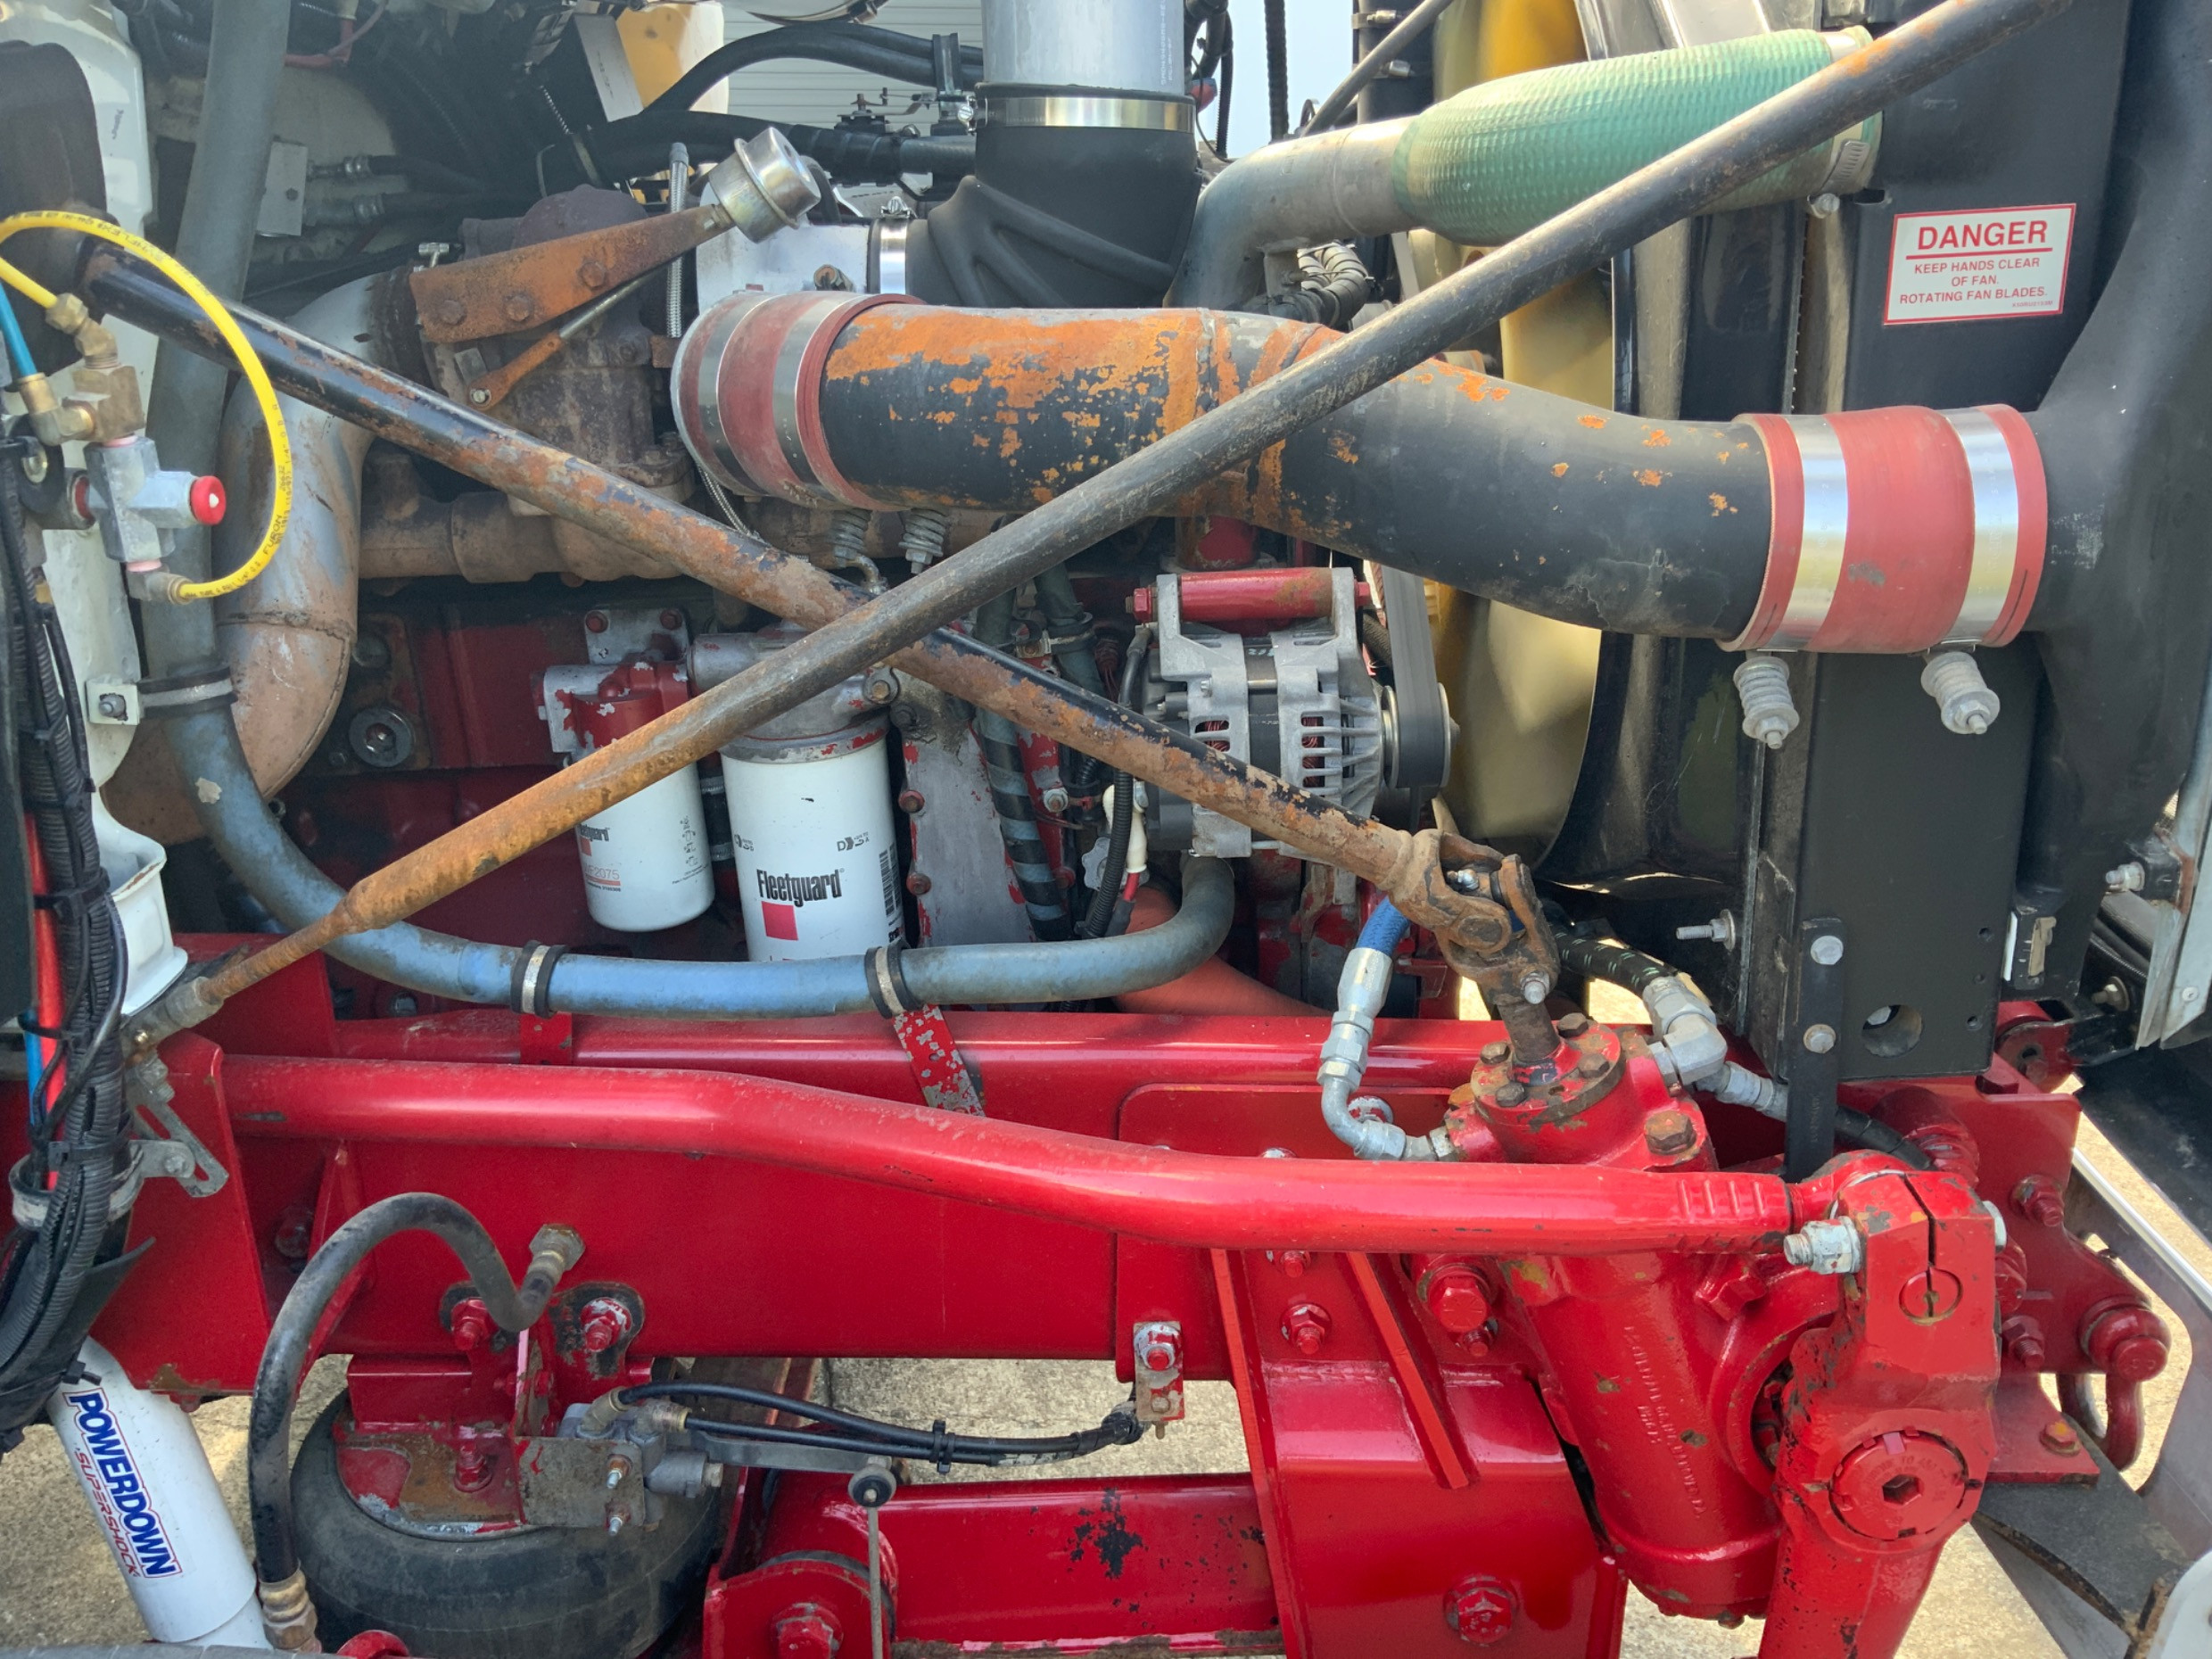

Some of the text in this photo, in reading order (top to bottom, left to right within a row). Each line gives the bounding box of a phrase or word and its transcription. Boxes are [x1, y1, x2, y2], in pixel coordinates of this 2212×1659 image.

[1918, 220, 2048, 250] DANGER
[1914, 258, 2040, 274] KEEP HANDS CLEAR
[1952, 275, 2000, 287] OF FAN.
[1900, 286, 2048, 304] ROTATING FAN BLADES.
[262, 514, 283, 556] FURON
[756, 869, 842, 908] Fleetguard
[67, 1392, 177, 1576] POWERDOWN
[76, 1450, 137, 1576] SUPERSHOCK
